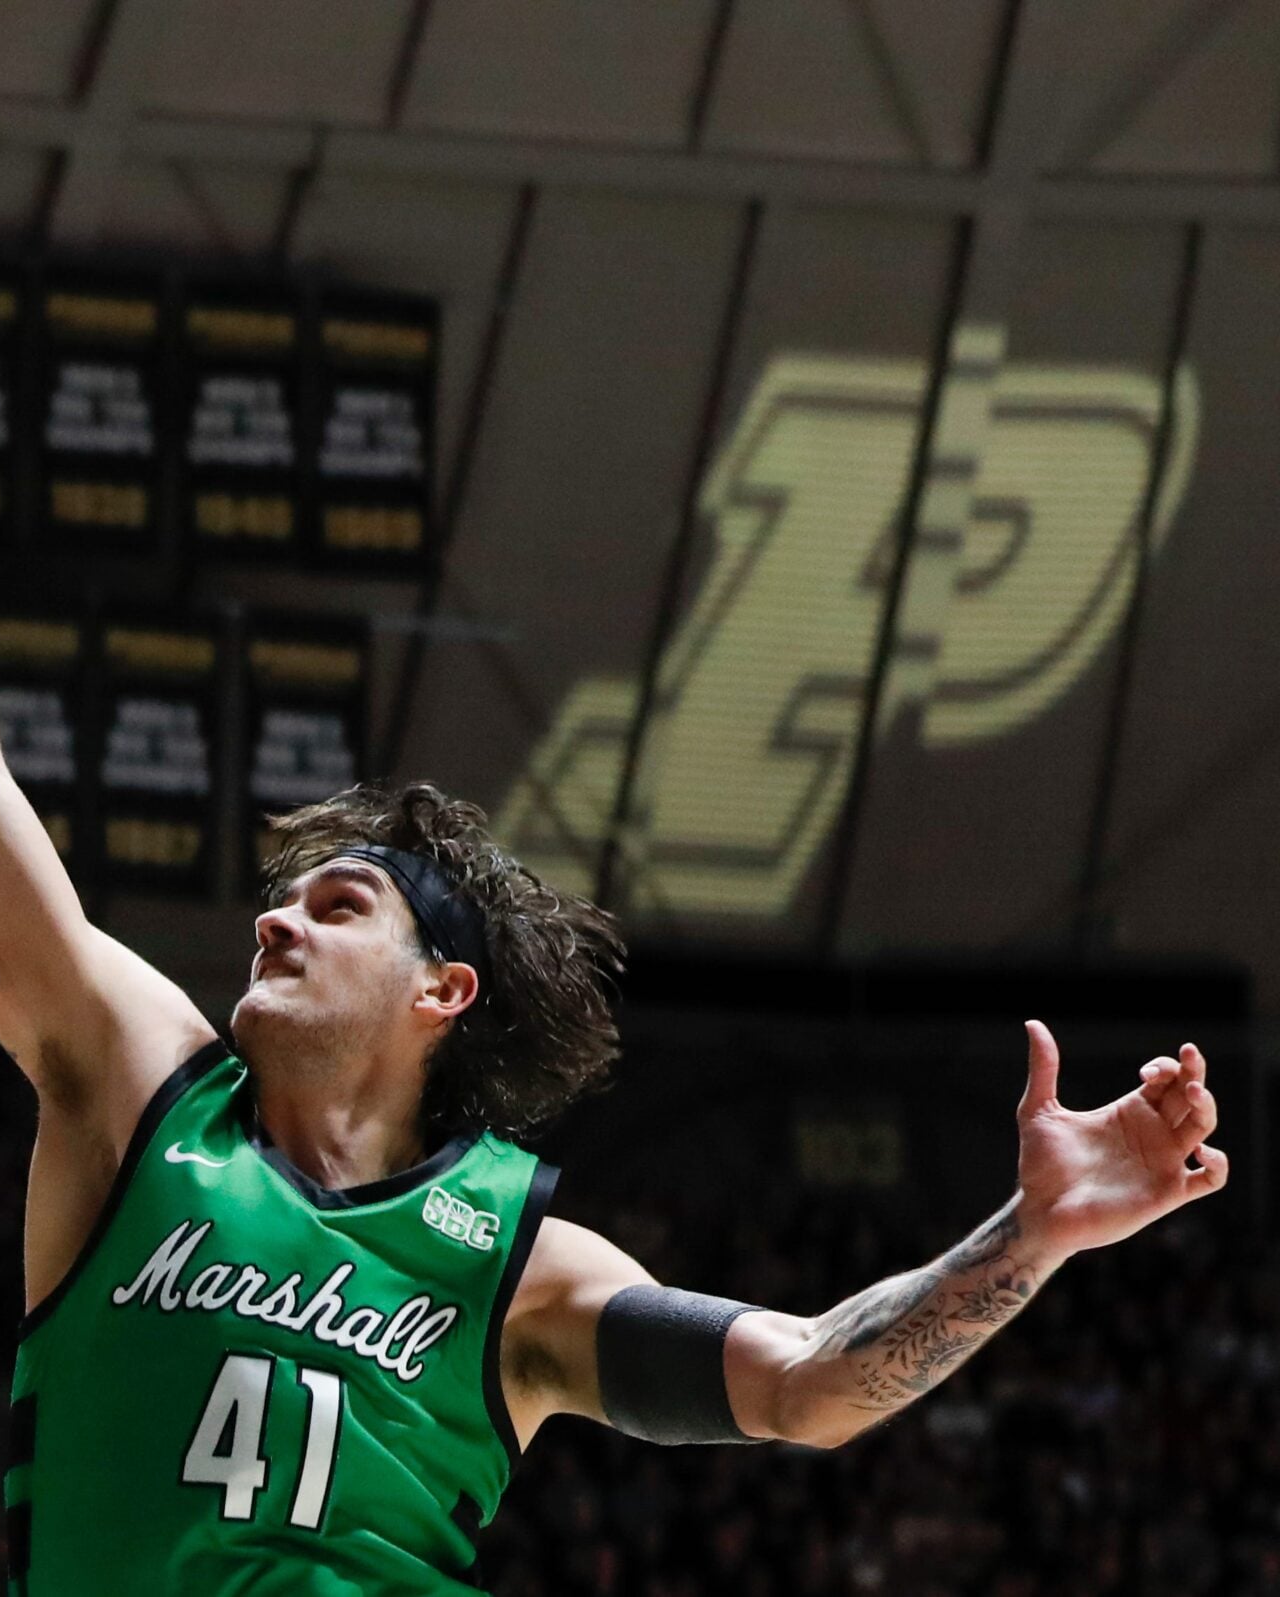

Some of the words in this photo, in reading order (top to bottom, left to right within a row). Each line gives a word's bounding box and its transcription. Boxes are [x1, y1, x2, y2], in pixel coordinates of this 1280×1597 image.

[422, 1186, 500, 1251] SBC
[111, 1220, 458, 1381] Marshall
[178, 1352, 344, 1531] 41
